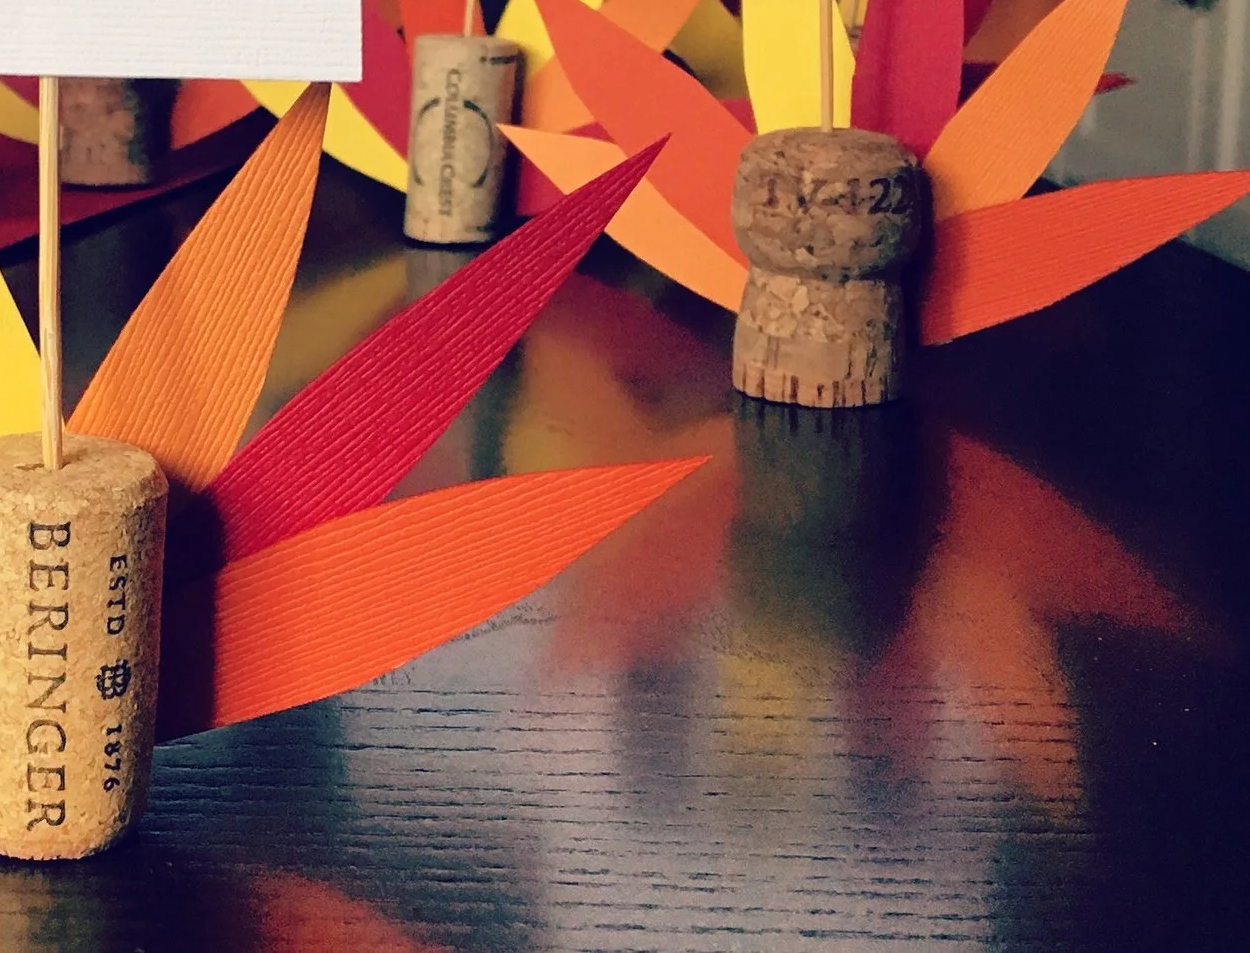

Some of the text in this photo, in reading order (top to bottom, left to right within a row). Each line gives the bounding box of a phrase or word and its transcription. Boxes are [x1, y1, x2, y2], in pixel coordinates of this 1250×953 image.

[26, 521, 71, 831] BERINGER
[103, 554, 128, 793] ESTD 1876
